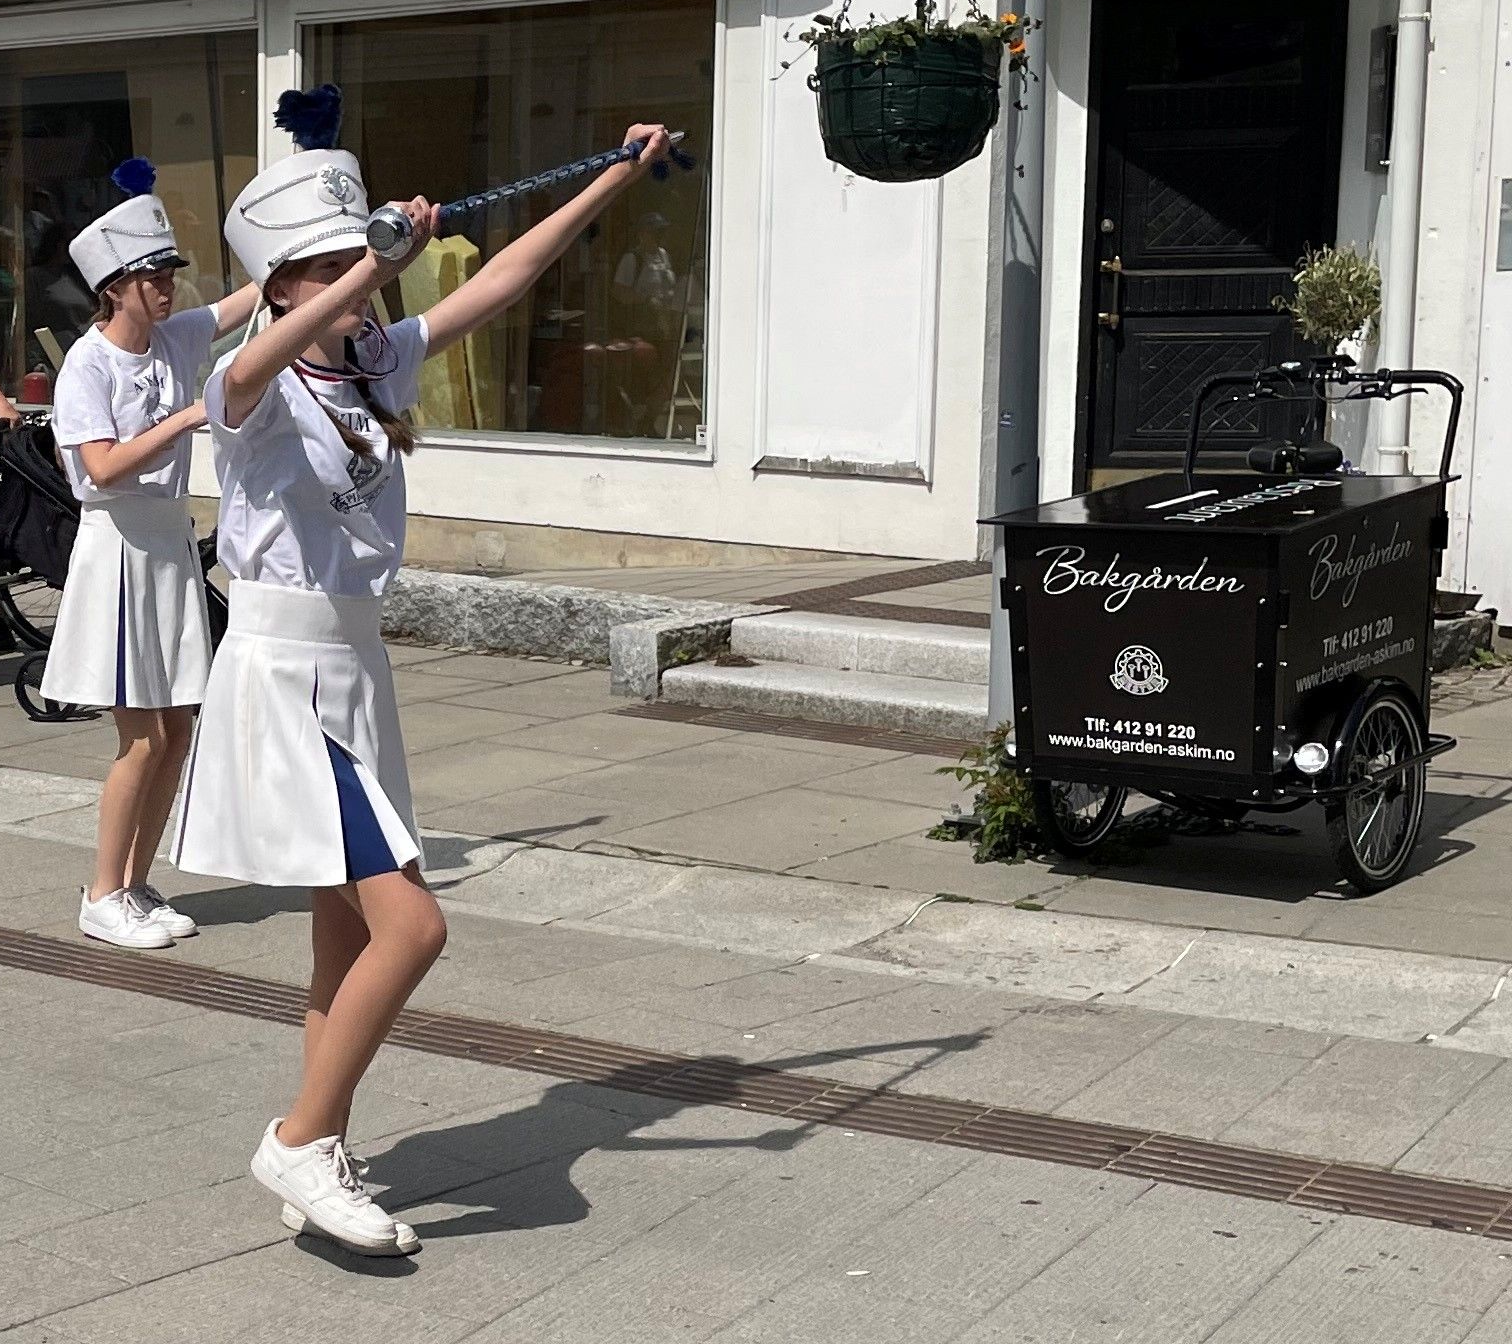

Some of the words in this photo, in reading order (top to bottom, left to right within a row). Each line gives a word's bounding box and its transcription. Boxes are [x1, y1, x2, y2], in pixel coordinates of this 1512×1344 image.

[1036, 545, 1246, 613] Bakgården
[1308, 521, 1411, 607] Bakgården
[1341, 627, 1359, 650] 412
[1361, 623, 1373, 643] 91
[1375, 616, 1394, 639] 220
[1085, 717, 1110, 733] Tlf:
[1113, 719, 1141, 736] 412
[1145, 722, 1162, 737] 91
[1167, 725, 1196, 740] 220
[1049, 733, 1235, 762] www.bakgarden-askim.no
